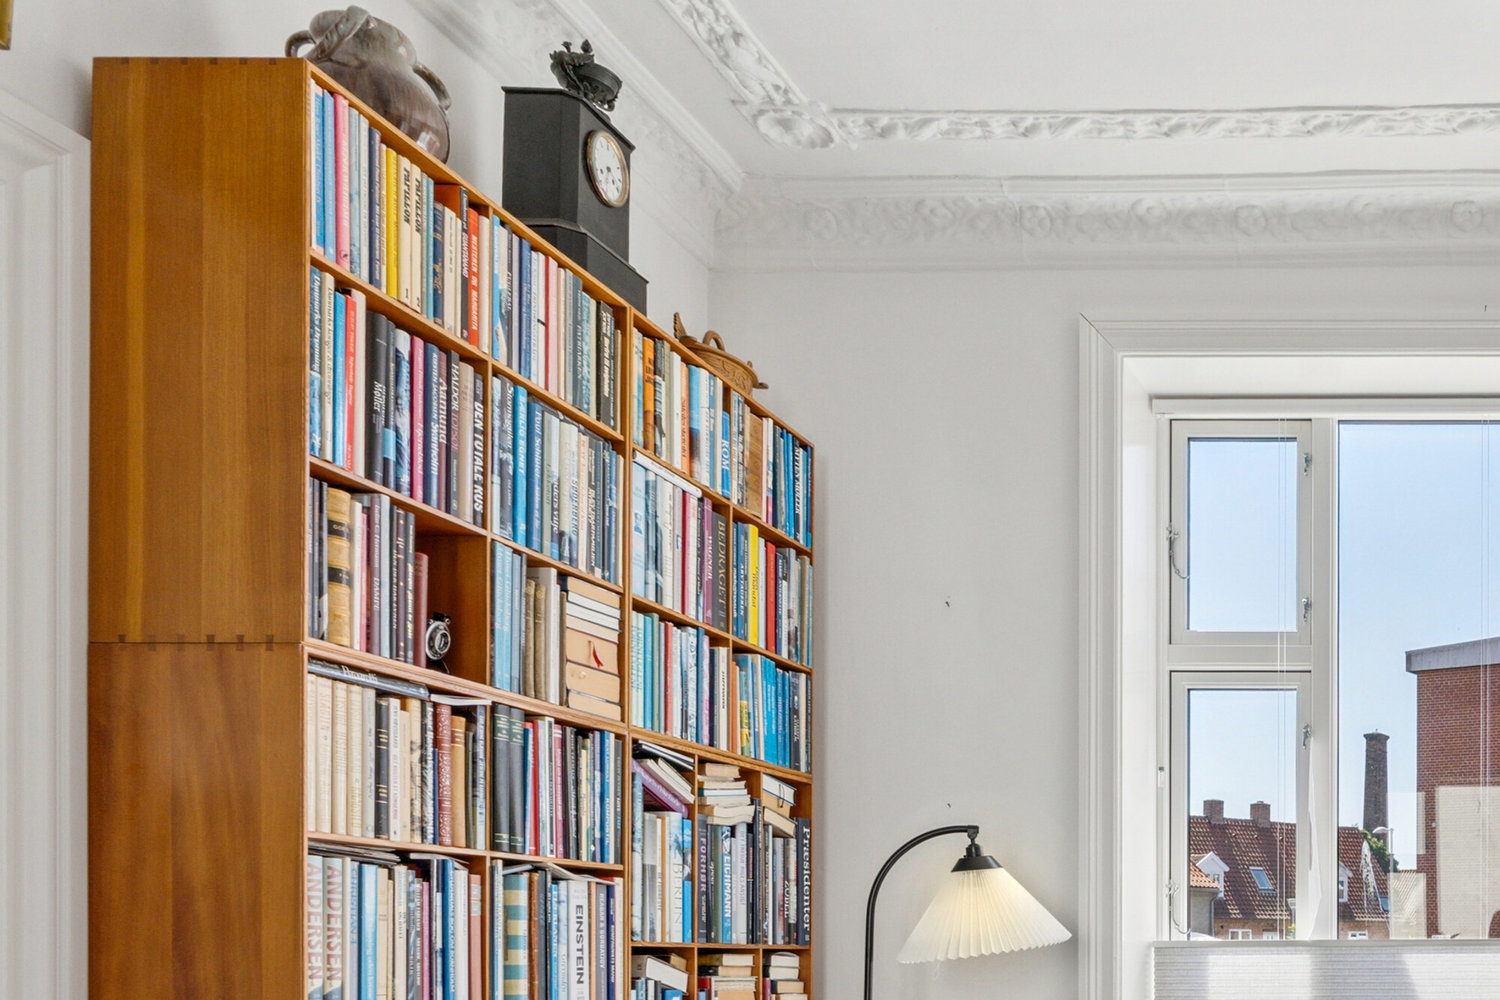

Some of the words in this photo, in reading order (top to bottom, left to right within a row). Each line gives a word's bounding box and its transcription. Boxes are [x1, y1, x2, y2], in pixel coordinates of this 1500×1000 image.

[472, 276, 477, 287] OG
[374, 381, 382, 412] Møller
[439, 378, 447, 444] Aamund
[474, 402, 483, 430] DEN
[534, 411, 542, 433] Poul
[474, 433, 483, 482] TOTALE
[474, 485, 483, 512] RUS
[718, 521, 726, 605] BEDRAGET
[672, 863, 682, 924] BERLIN
[308, 863, 322, 980] ANDERSEN
[327, 866, 342, 982] ANDERSEN
[576, 905, 584, 984] EINSTEIN
